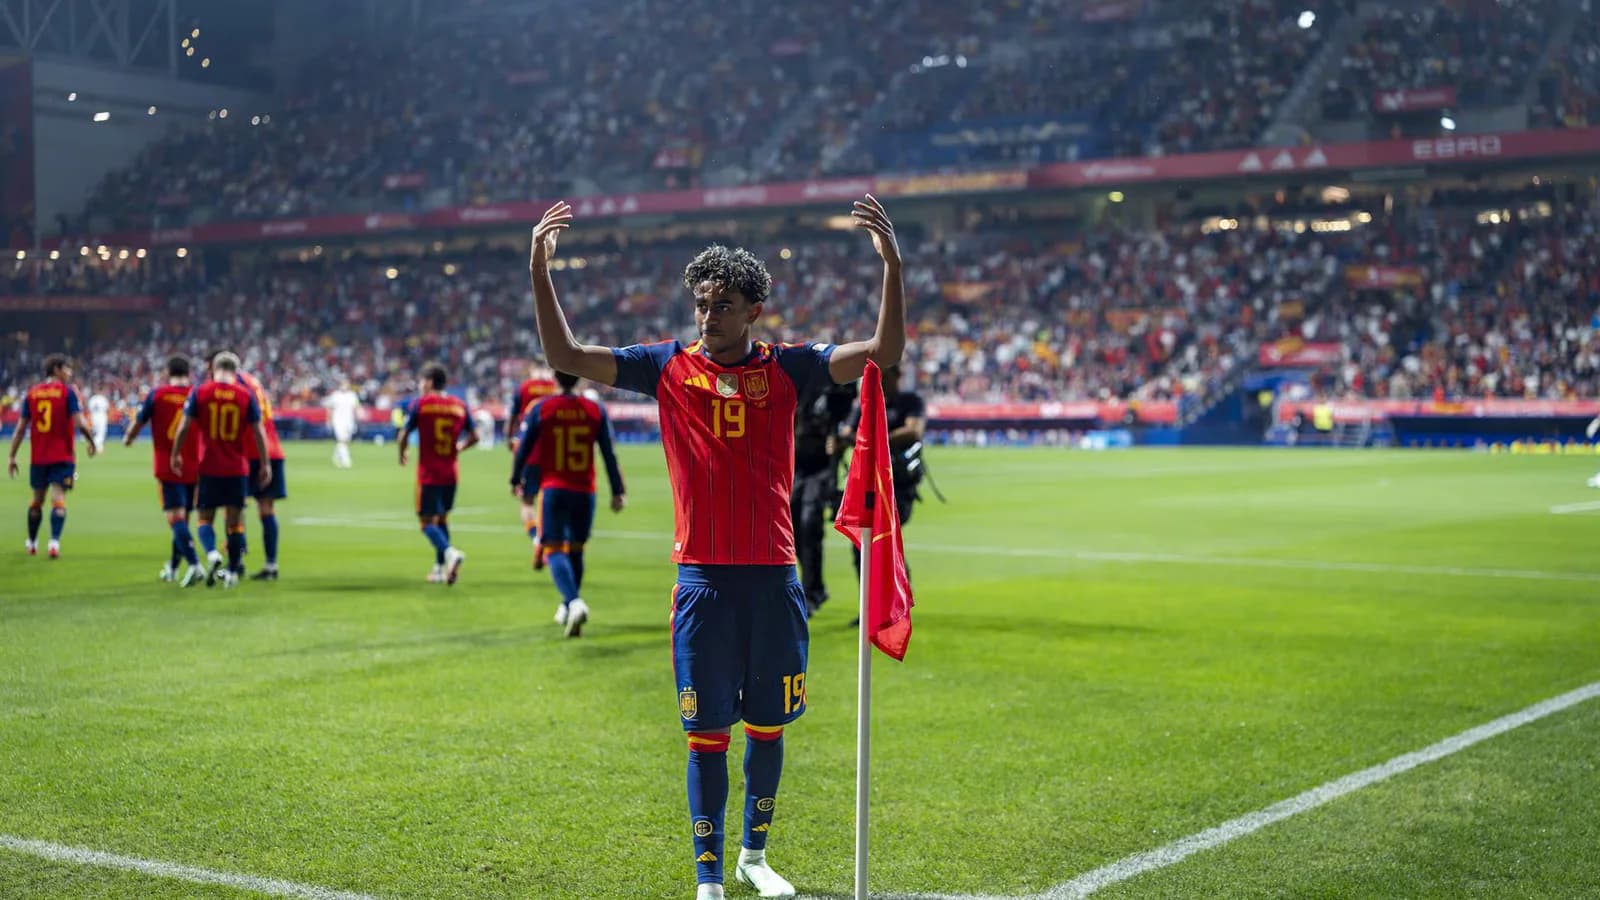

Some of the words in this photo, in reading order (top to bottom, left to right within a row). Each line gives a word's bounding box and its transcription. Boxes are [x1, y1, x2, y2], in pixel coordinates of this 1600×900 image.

[1412, 135, 1501, 160] EBRO
[36, 399, 52, 433] 3
[208, 402, 240, 441] 10
[711, 399, 746, 438] 19
[434, 418, 453, 456] 5
[551, 425, 590, 471] 15
[783, 672, 806, 714] 19
